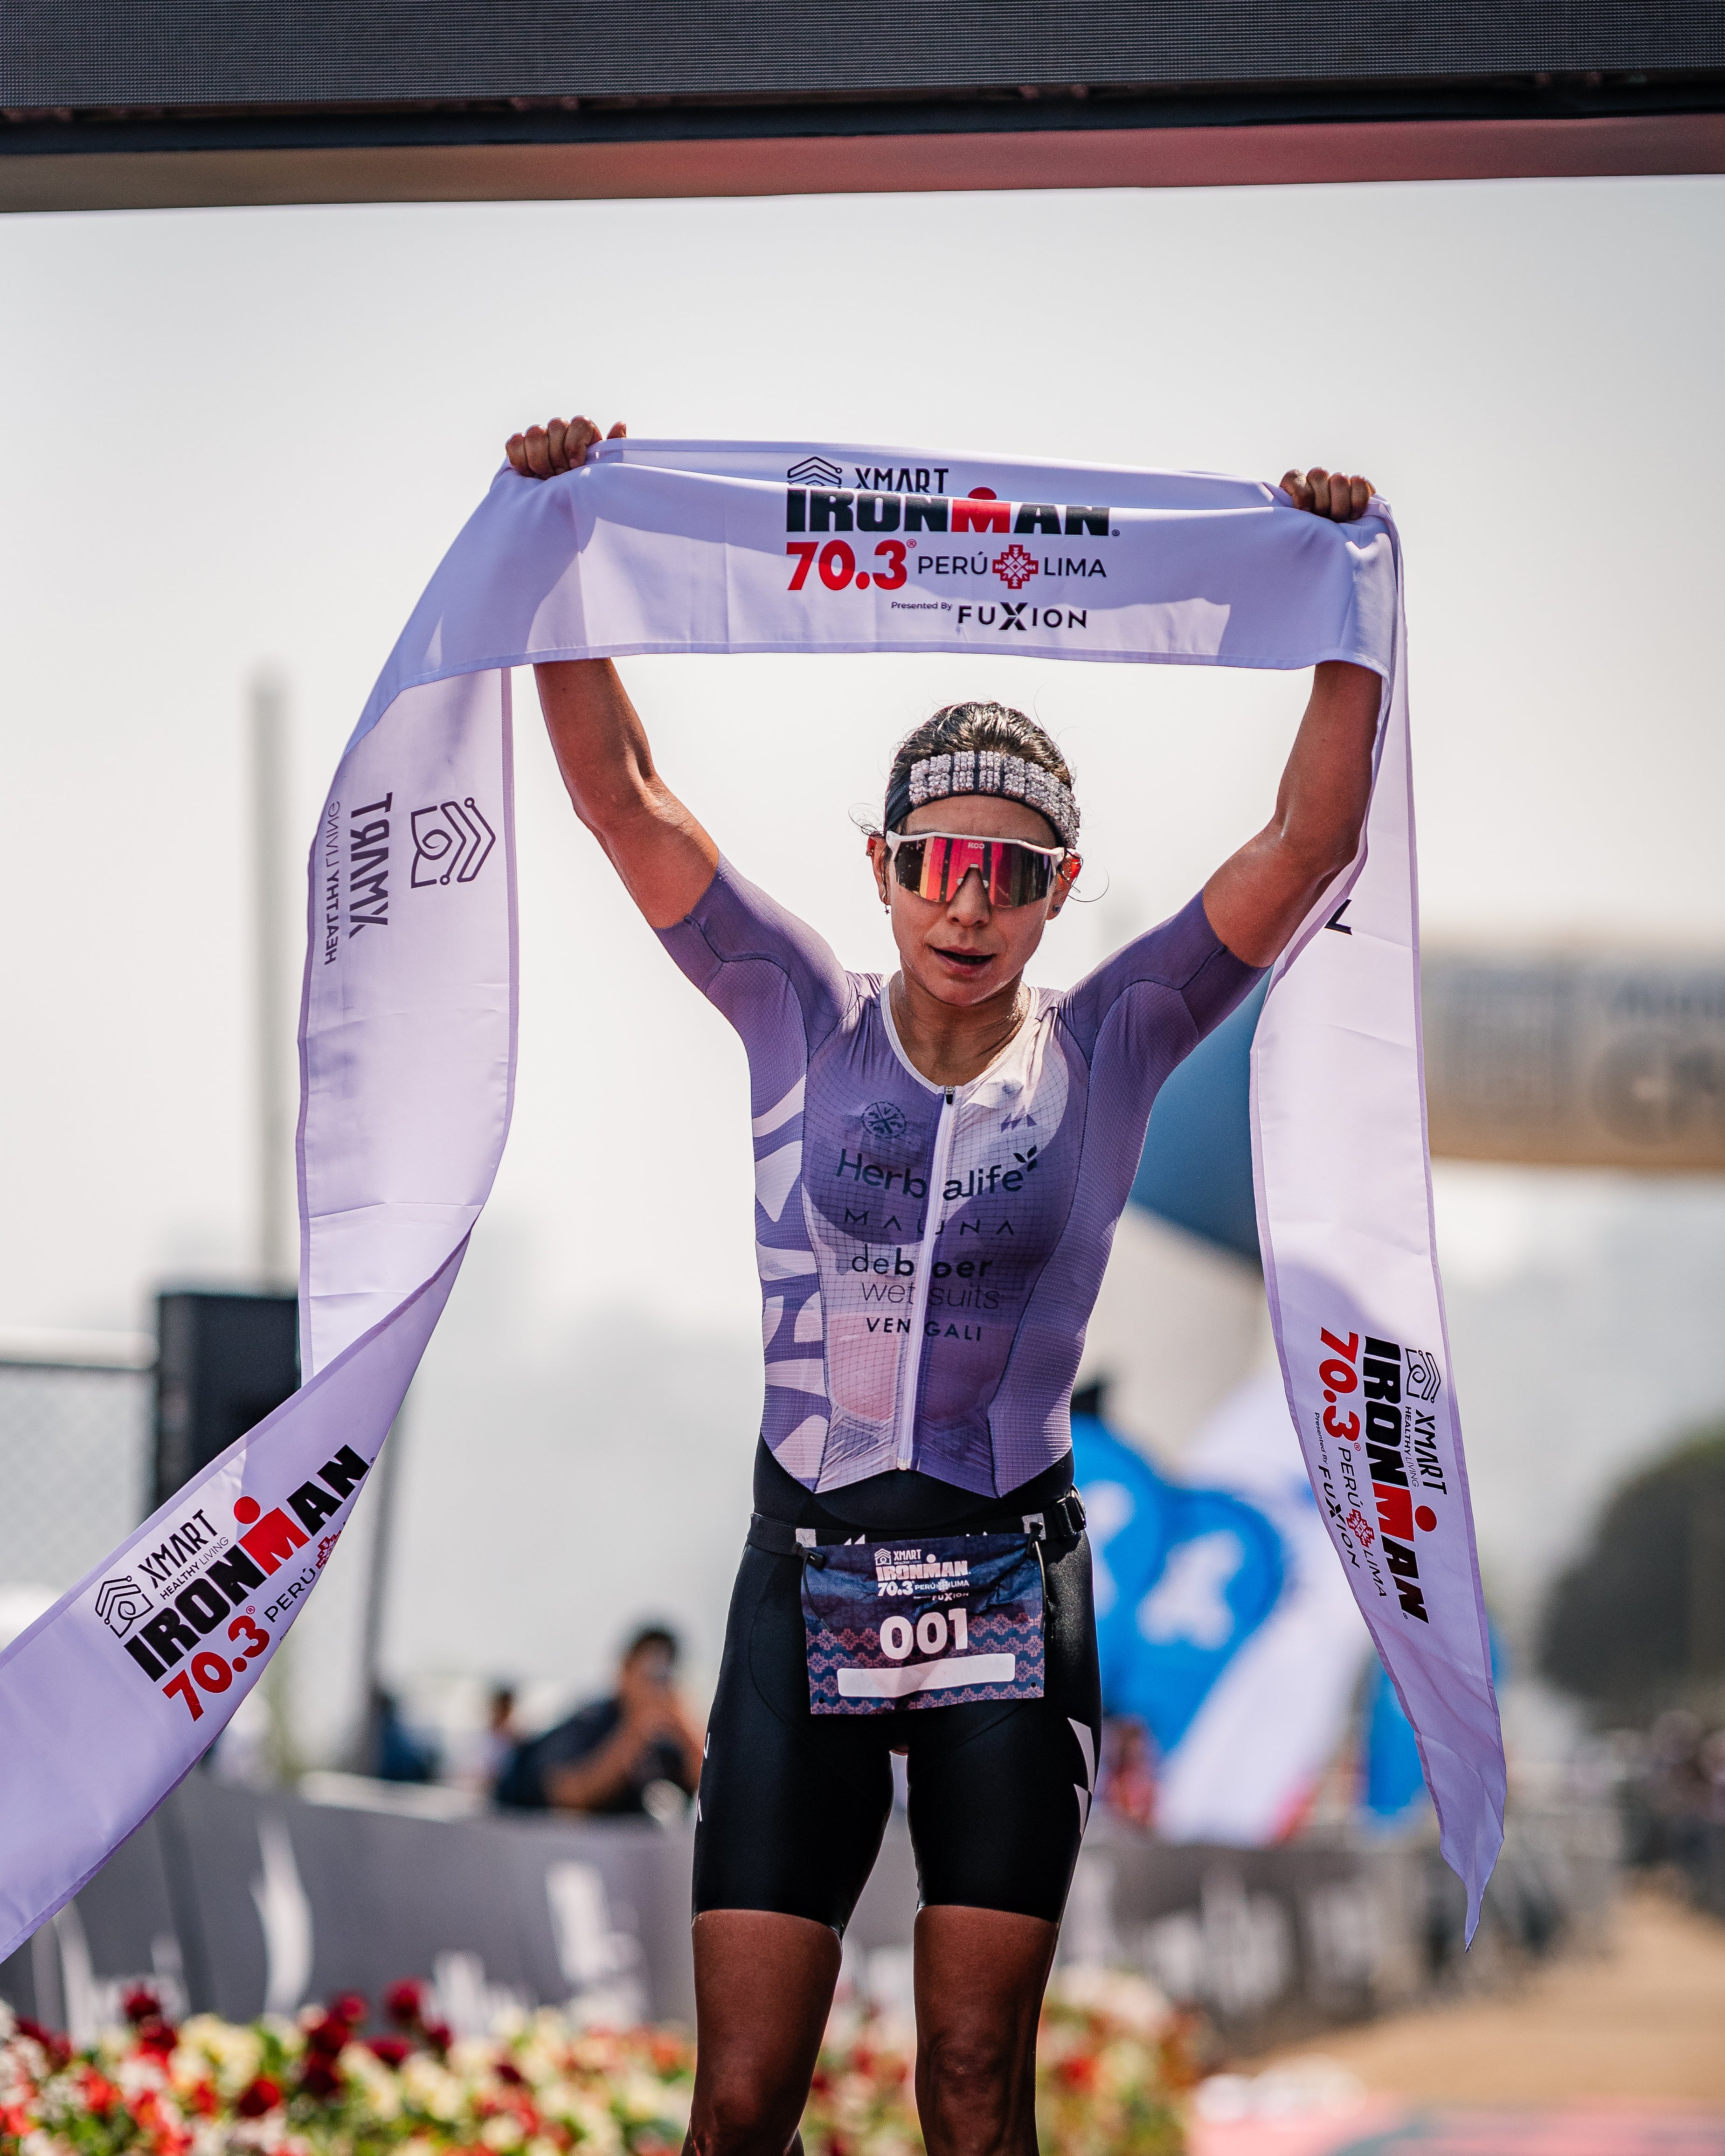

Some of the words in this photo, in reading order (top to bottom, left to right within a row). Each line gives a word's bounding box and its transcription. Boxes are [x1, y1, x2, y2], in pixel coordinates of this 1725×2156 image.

[854, 467, 949, 494] XMART
[918, 552, 988, 576] PERÚ
[1044, 556, 1108, 578] LIMA
[941, 602, 953, 611] By
[957, 601, 1087, 631] FUXION
[836, 1148, 1024, 1201] Herbalife
[1314, 1412, 1327, 1453] Presented
[1323, 1453, 1328, 1465] By
[1414, 1408, 1448, 1495] XMART
[1318, 1465, 1361, 1569] FUXION
[1338, 1446, 1364, 1508] PERÚ
[1363, 1549, 1387, 1597] LIMA
[137, 1509, 218, 1589] XMART
[159, 1561, 201, 1600] HEALTHY
[201, 1536, 229, 1566] LIVING
[894, 1549, 921, 1561] XMART
[263, 1568, 317, 1623] PERÚ
[914, 1582, 936, 1590] PERÚ
[880, 1608, 969, 1660] 001
